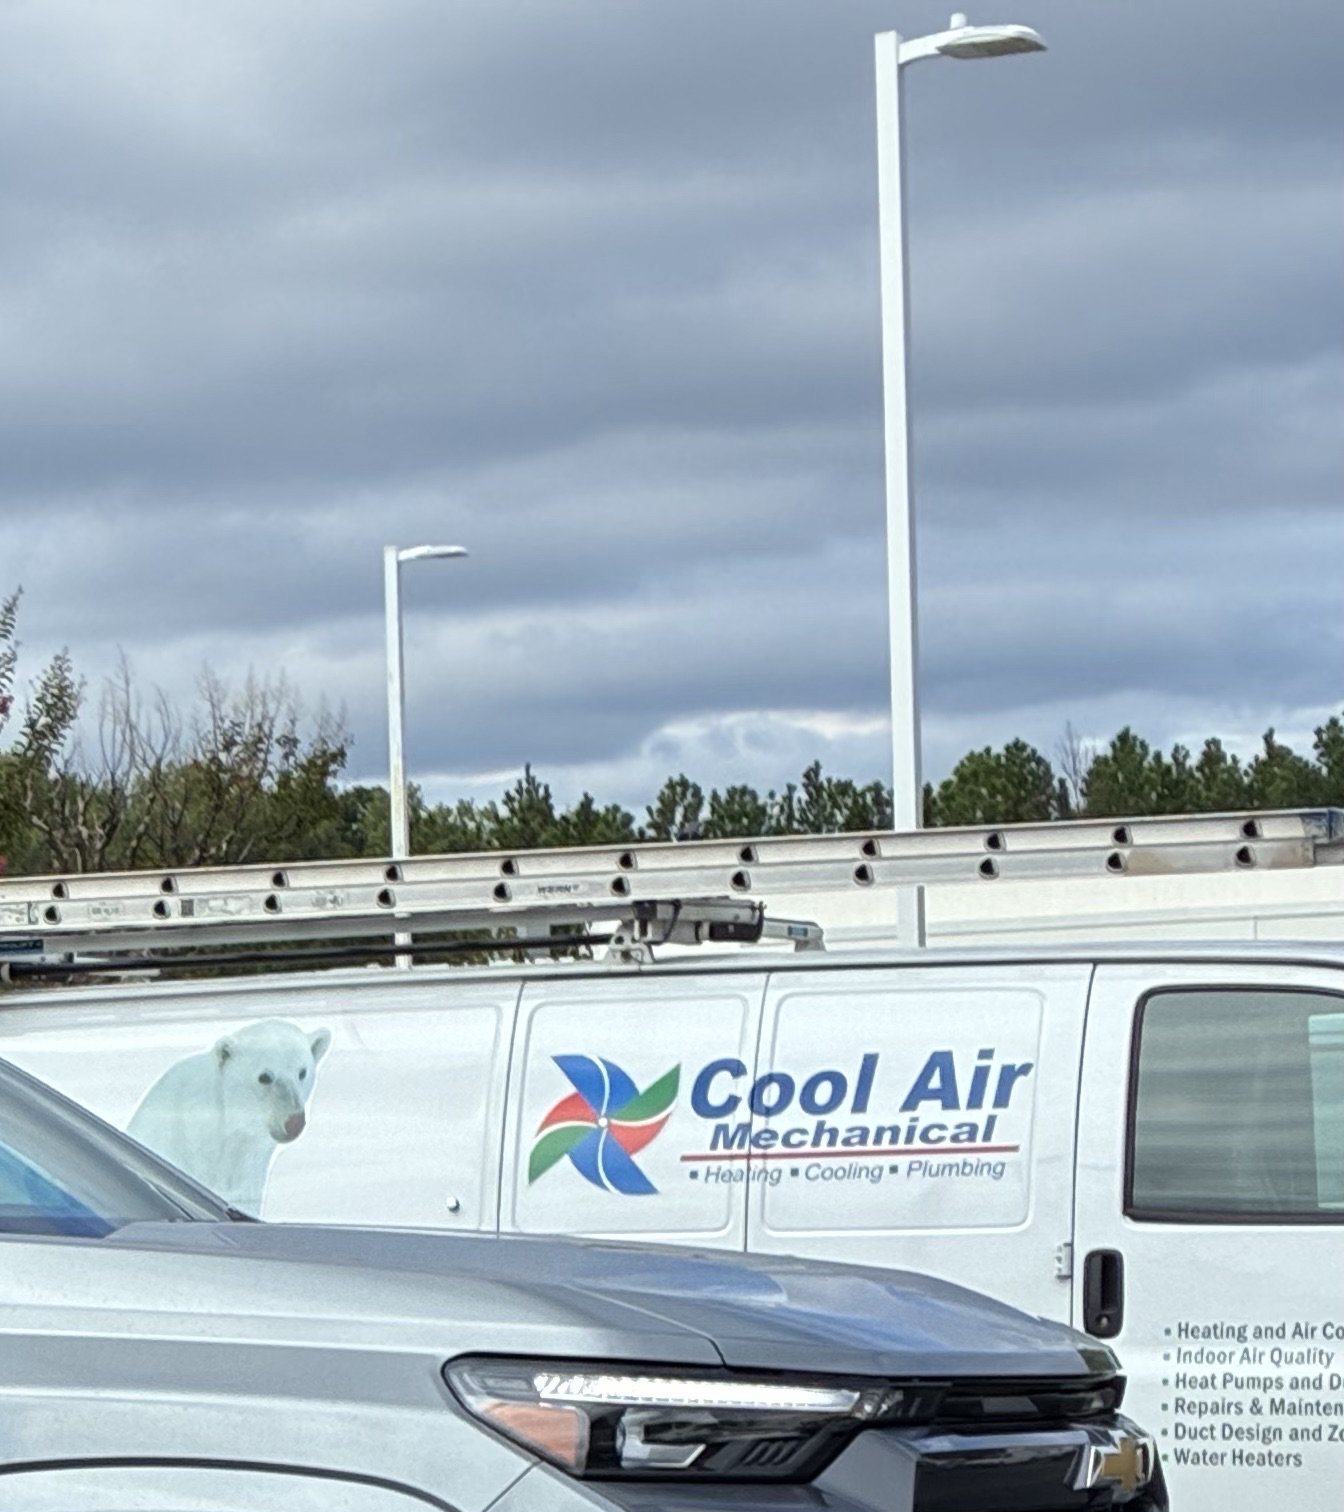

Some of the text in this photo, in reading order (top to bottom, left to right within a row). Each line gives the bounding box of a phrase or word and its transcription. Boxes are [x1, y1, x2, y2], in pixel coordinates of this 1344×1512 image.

[691, 1048, 1034, 1119] Cool Air
[709, 1114, 998, 1151] Mechanical
[704, 1158, 1006, 1186] Heating Cooling Plumbing
[1177, 1322, 1248, 1343] Heating
[1252, 1321, 1286, 1340] and
[1291, 1321, 1318, 1340] Air
[1176, 1346, 1335, 1369] Indoor Air Quality
[1175, 1371, 1344, 1393] Heat Pumps and D
[1174, 1397, 1244, 1418] Repairs
[1249, 1397, 1265, 1416] &
[1174, 1422, 1216, 1441] Duct
[1221, 1423, 1283, 1446] Design
[1288, 1423, 1323, 1442] and
[1173, 1448, 1303, 1468] Water Heaters
